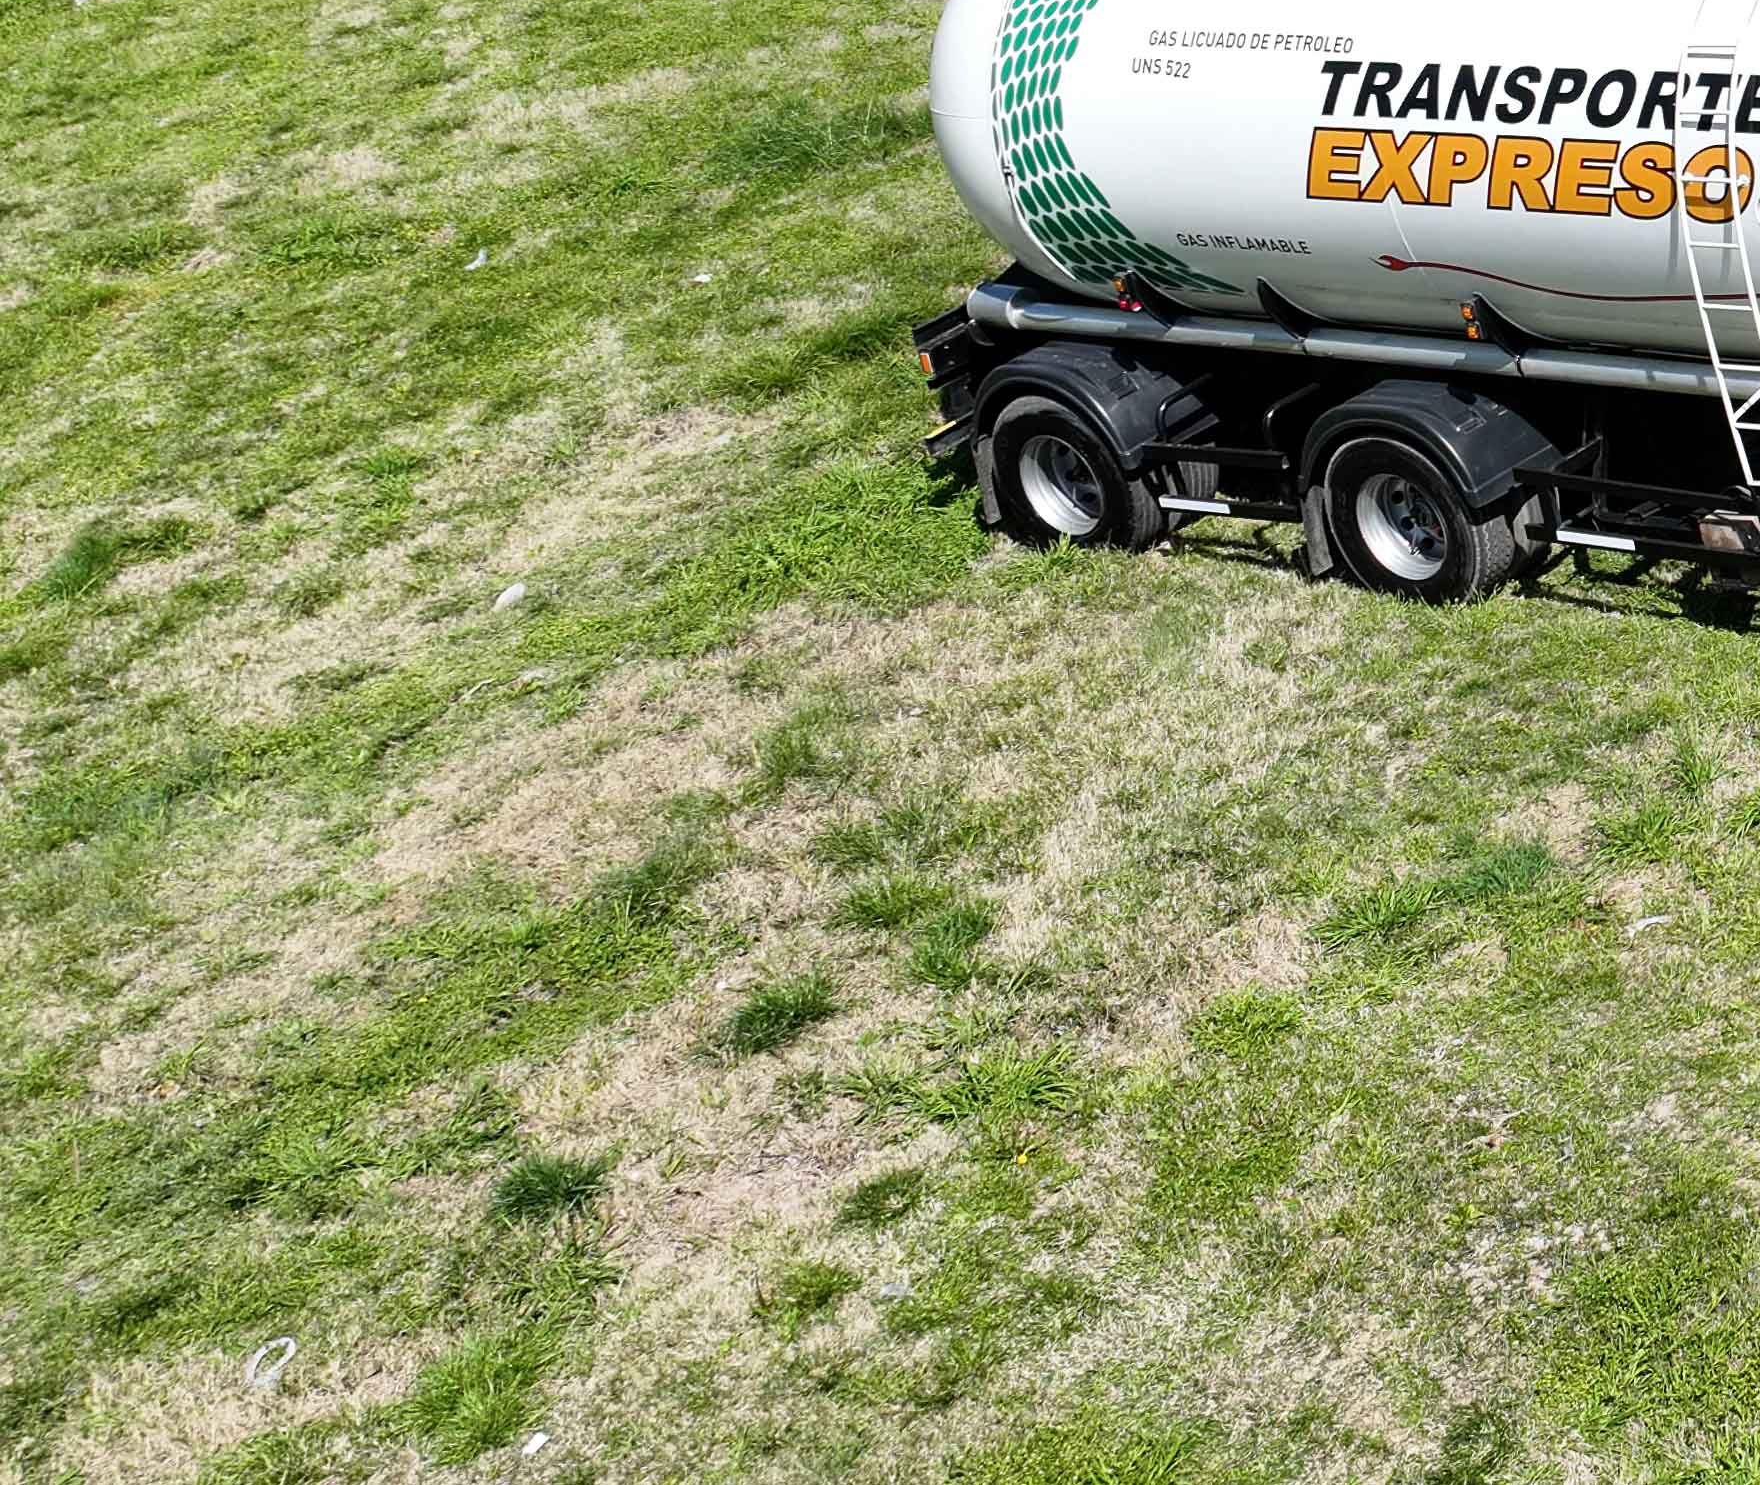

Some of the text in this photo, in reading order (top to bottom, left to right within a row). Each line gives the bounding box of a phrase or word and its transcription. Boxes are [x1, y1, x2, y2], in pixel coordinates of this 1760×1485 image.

[1148, 29, 1354, 54] GAS LICUADO DE PETROLEO
[1131, 58, 1191, 79] UNS 522
[1306, 126, 1755, 224] EXPRESO
[1176, 233, 1312, 255] GAS INFLAMABLE
